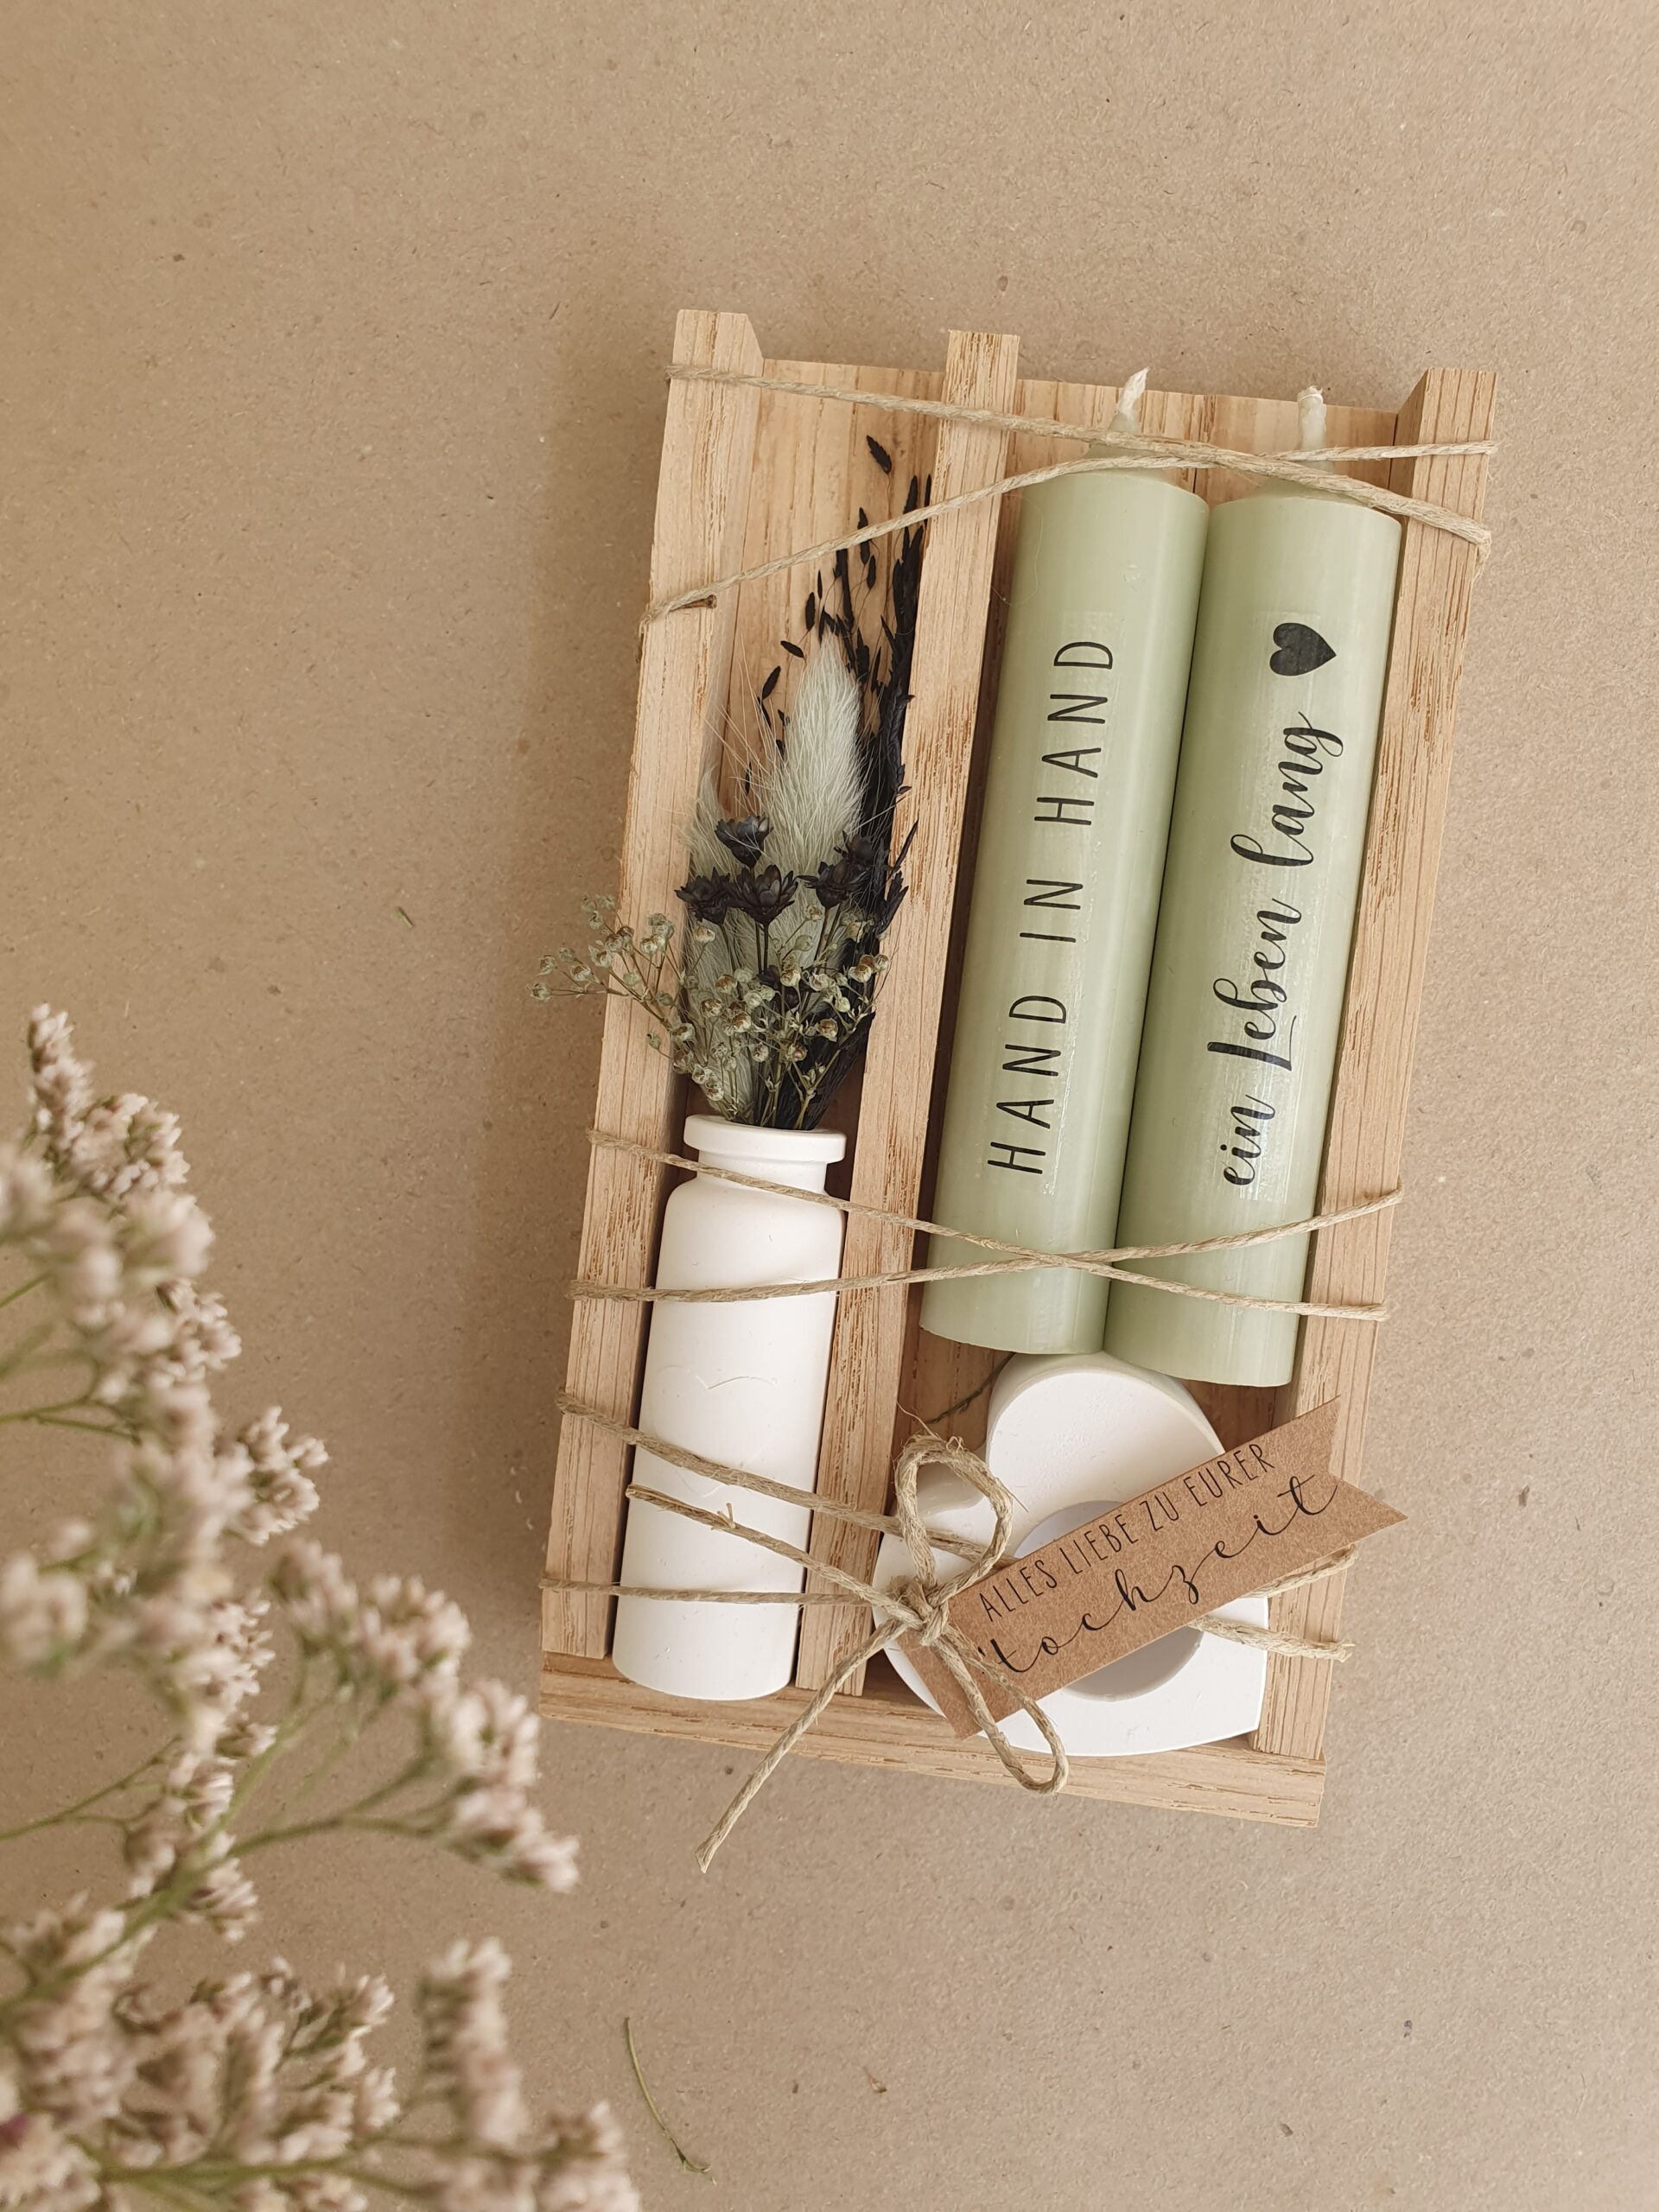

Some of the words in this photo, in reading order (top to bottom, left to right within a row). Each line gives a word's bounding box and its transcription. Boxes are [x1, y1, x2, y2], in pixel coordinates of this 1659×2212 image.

[1033, 641, 1113, 825] HAND
[1230, 711, 1344, 867] lang
[1019, 879, 1083, 943] IN
[1205, 898, 1302, 1071] Leben
[987, 995, 1066, 1173] HAND
[1219, 1094, 1276, 1186] ein
[978, 1559, 1058, 1622] ALLES
[1064, 1515, 1139, 1574] LIEBE
[1139, 1495, 1180, 1532] ZU
[1184, 1443, 1276, 1507] EURER
